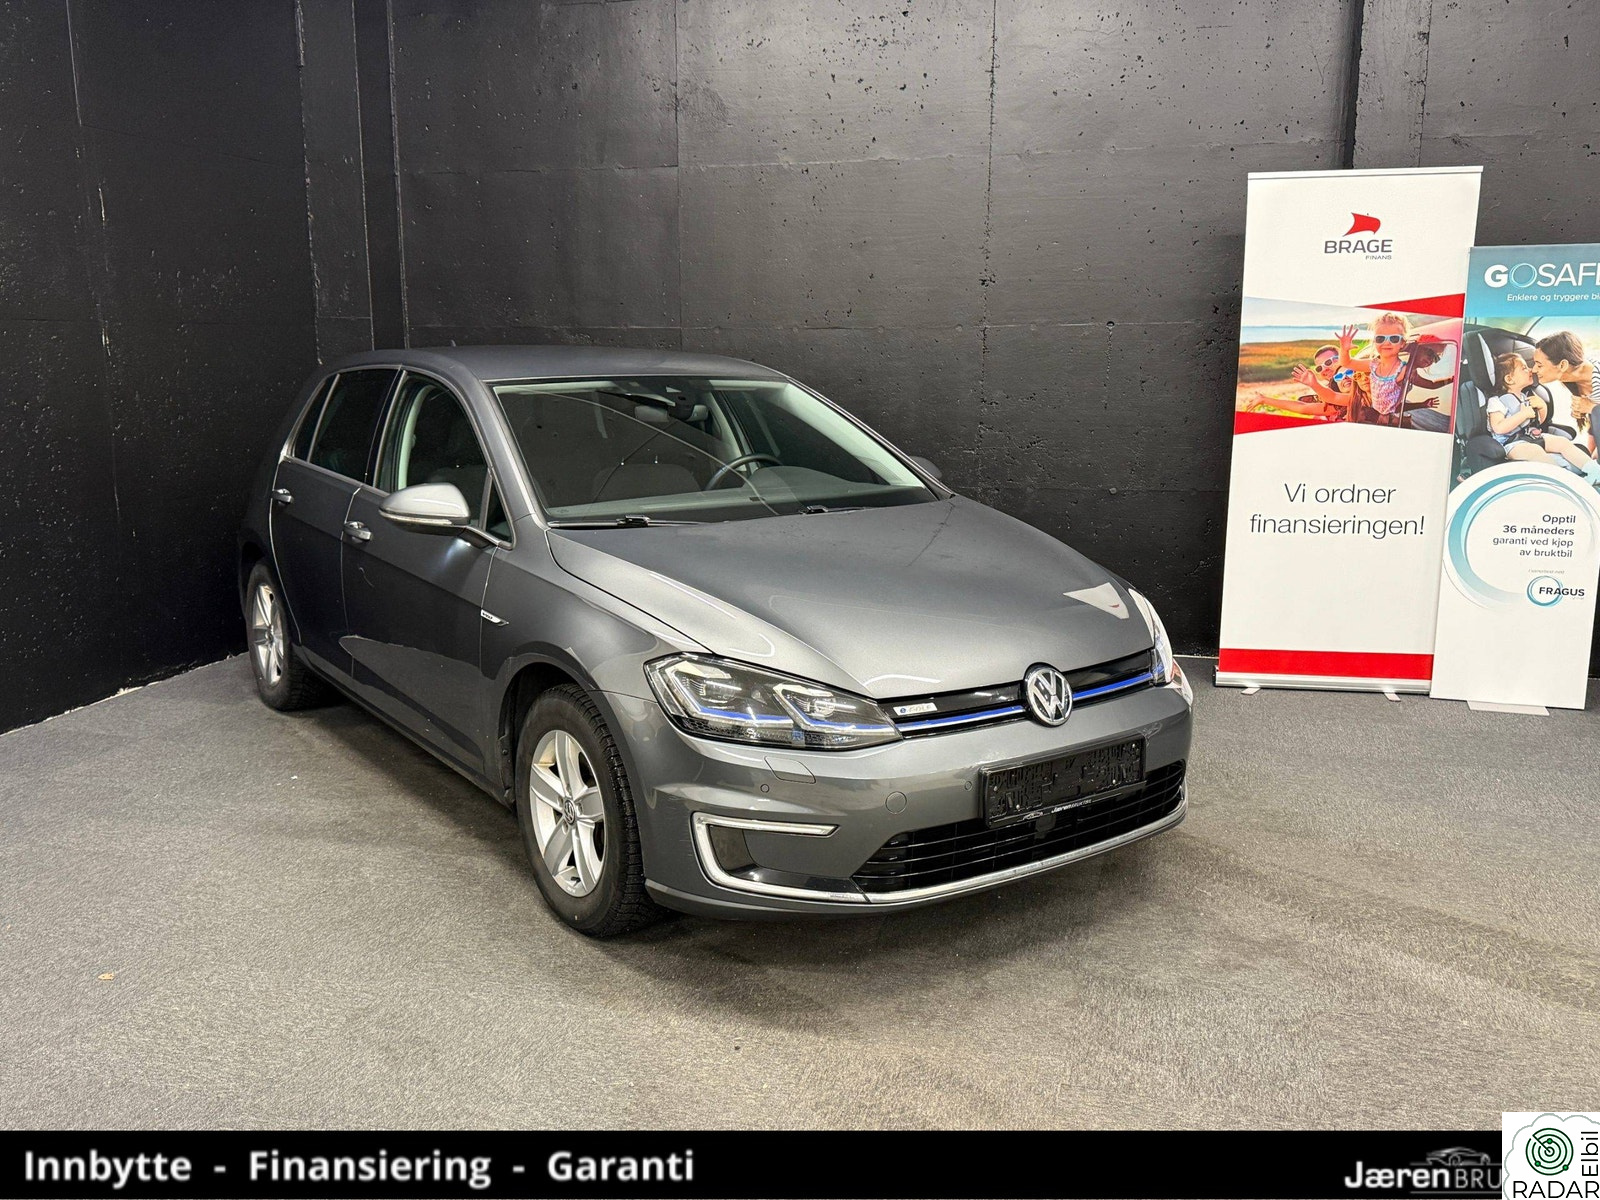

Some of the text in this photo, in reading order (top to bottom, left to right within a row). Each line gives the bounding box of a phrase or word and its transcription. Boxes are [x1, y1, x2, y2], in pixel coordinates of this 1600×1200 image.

[1324, 239, 1393, 254] BRAGE
[1506, 293, 1538, 302] Enklere
[1540, 295, 1551, 303] og
[1553, 293, 1589, 303] tryggere
[1284, 483, 1397, 504] Vi ordner
[1542, 514, 1576, 525] Opptil
[1250, 513, 1425, 540] finansieringen!
[1502, 525, 1575, 536] 36 måneders
[1492, 537, 1574, 549] garanti ved kjøp
[1534, 548, 1573, 558] bruktbil
[1538, 586, 1585, 597] FRAGUS
